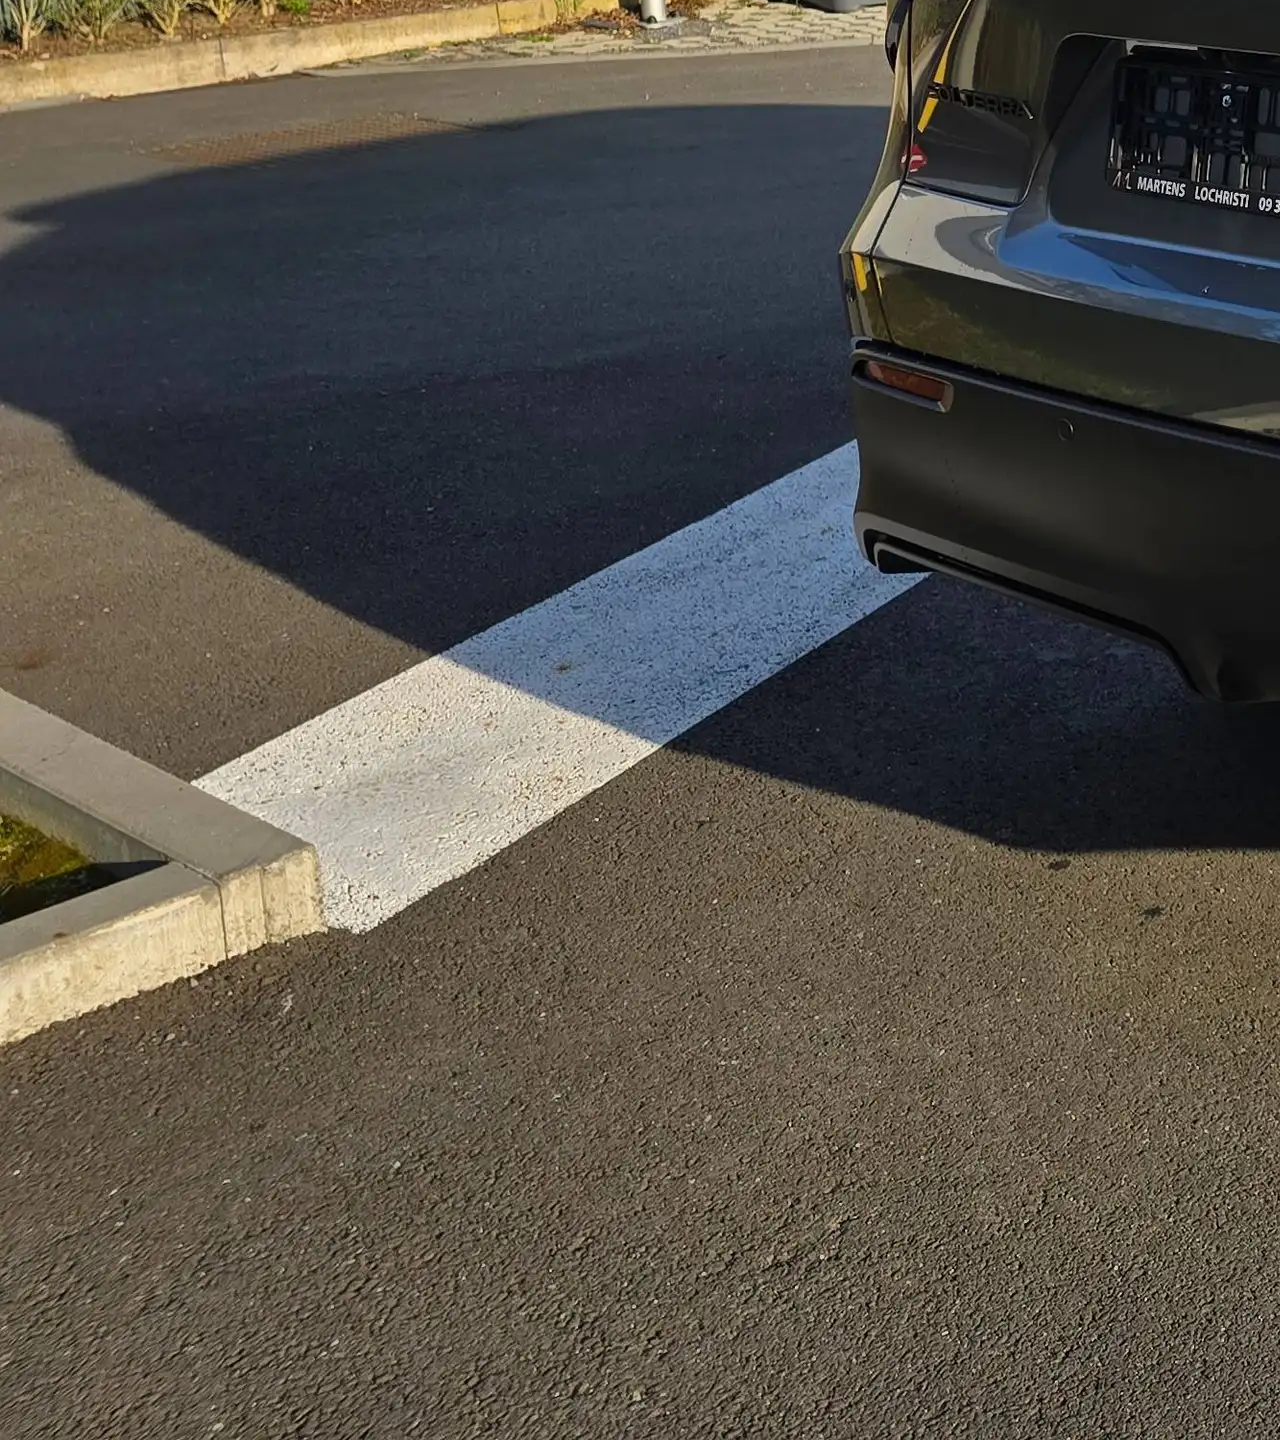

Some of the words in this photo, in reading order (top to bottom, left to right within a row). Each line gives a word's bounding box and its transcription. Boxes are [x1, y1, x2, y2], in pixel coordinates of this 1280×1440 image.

[1136, 176, 1187, 198] MARTENS
[1194, 185, 1250, 208] LOCHRISTI
[1258, 197, 1272, 211] 09
